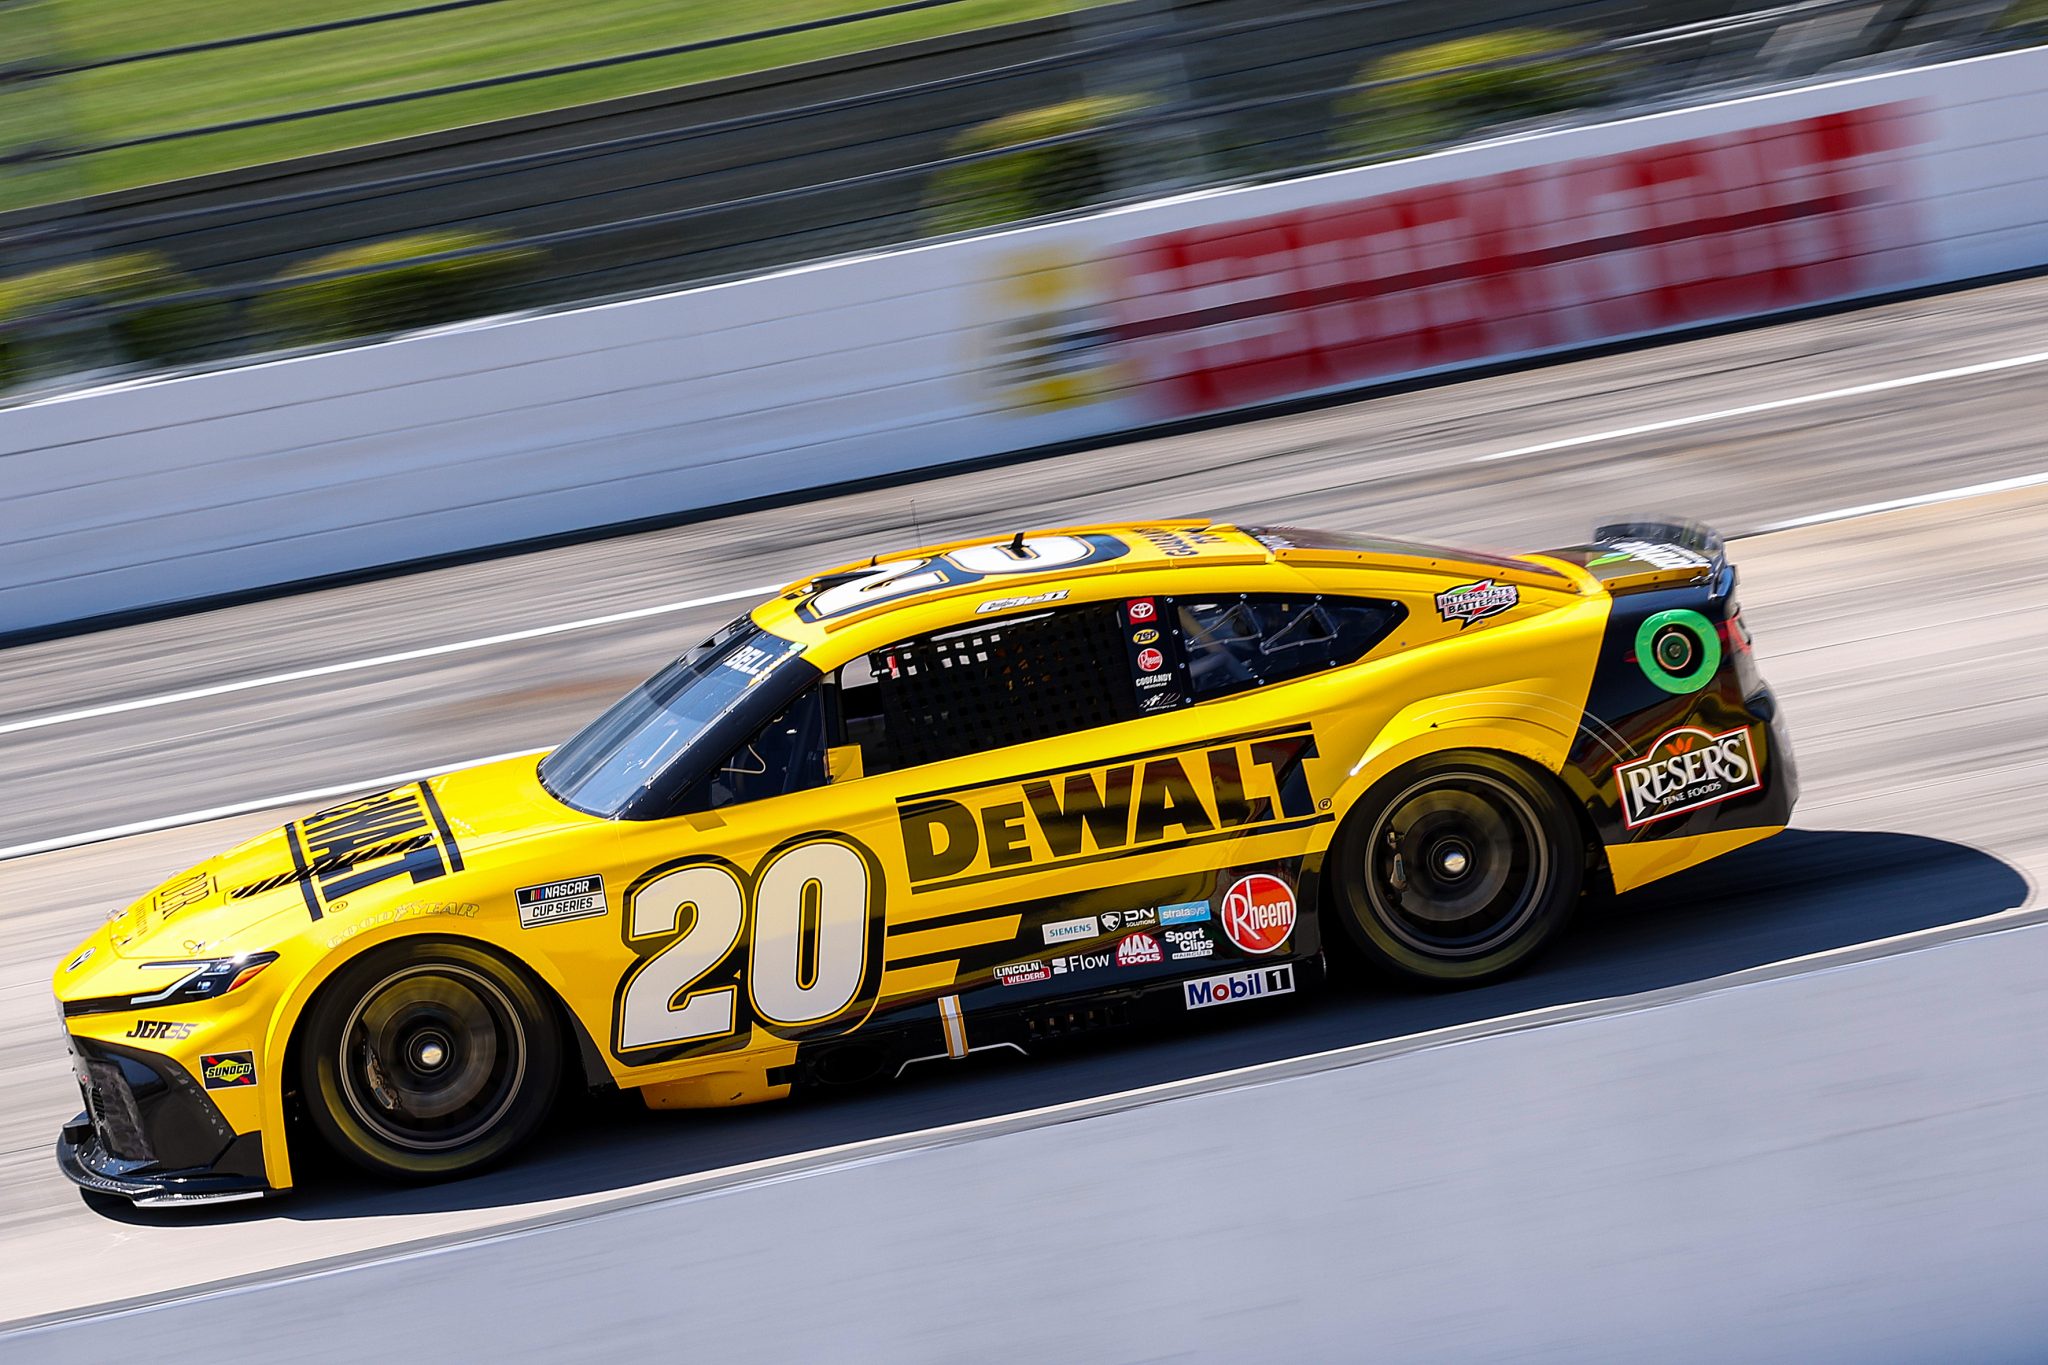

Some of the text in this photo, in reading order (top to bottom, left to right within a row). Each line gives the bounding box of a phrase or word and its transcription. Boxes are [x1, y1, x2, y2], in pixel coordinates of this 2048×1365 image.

[805, 535, 1096, 618] 20
[1442, 588, 1511, 604] INTERSTATE
[1448, 596, 1513, 614] BATTERIES
[723, 645, 774, 676] BELL
[1626, 738, 1749, 818] RESER'S
[1662, 781, 1722, 806] FINE FOODS
[545, 881, 590, 899] NASCAR
[532, 897, 593, 918] CUP SERIES
[1124, 907, 1155, 921] DN
[1163, 906, 1206, 919] stratasys
[1229, 879, 1292, 941] Rheem
[326, 900, 480, 949] GOODYEAR
[1049, 923, 1092, 937] SIEMENS
[1126, 918, 1156, 928] SOLUTIONS
[1165, 928, 1205, 944] Sport
[618, 838, 872, 1053] 20
[1117, 934, 1160, 957] MAC
[1173, 949, 1212, 959] HAIRCUTS
[1180, 939, 1214, 953] Clips
[1069, 954, 1110, 973] Flow
[1118, 952, 1162, 965] TOOLS
[996, 961, 1040, 977] LINCOLN
[1007, 972, 1046, 984] WELDERS
[1187, 970, 1283, 1006] Mobil 1
[207, 1063, 252, 1078] SUNOCO
